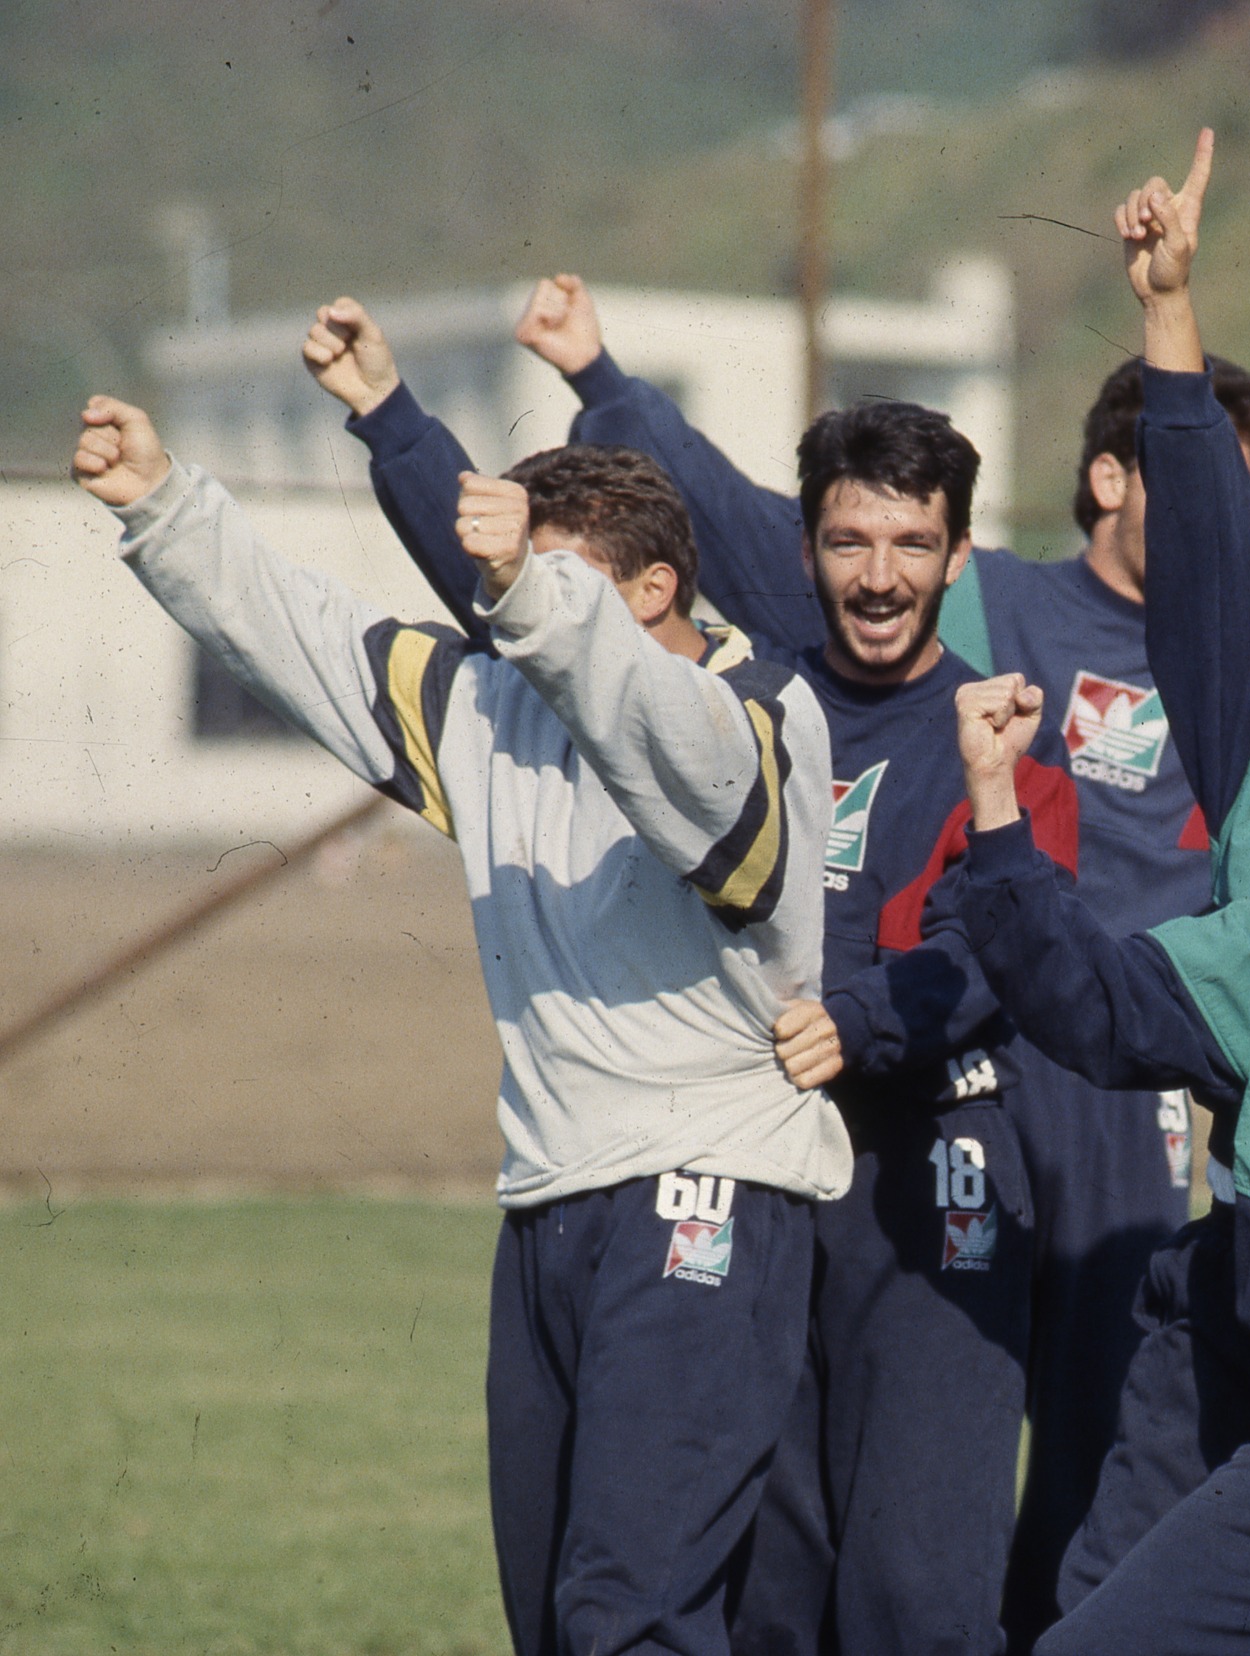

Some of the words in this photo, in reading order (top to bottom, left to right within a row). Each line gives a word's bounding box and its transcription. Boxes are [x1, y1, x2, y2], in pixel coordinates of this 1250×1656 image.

[1071, 759, 1146, 792] adidas
[929, 1138, 985, 1208] 18
[674, 1268, 721, 1287] adidas
